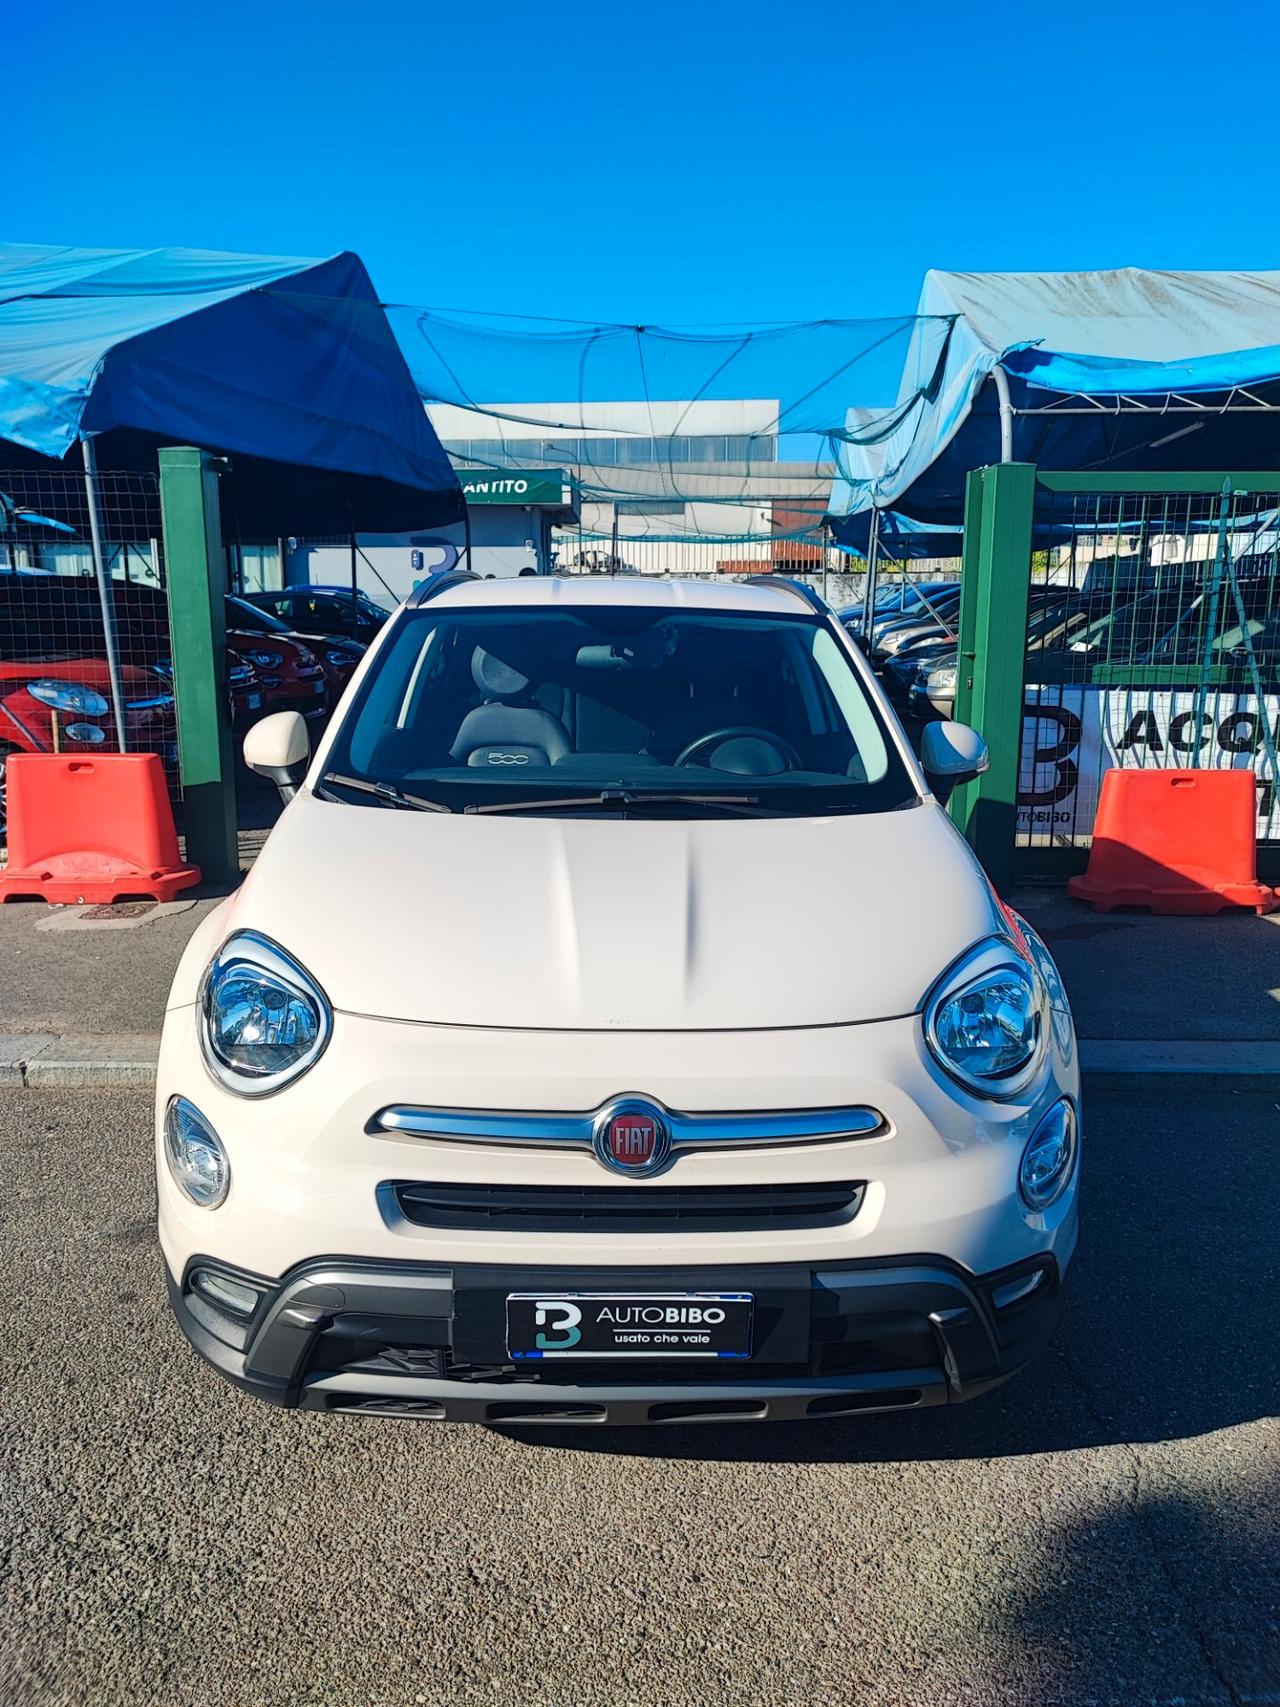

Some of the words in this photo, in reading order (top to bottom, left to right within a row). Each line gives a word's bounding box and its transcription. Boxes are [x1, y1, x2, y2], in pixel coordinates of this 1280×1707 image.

[487, 752, 529, 765] 500
[615, 1127, 652, 1155] FIAT
[596, 1307, 726, 1324] AUTOBIBO
[614, 1334, 651, 1343] usato
[653, 1333, 679, 1343] che
[682, 1334, 711, 1344] vale
